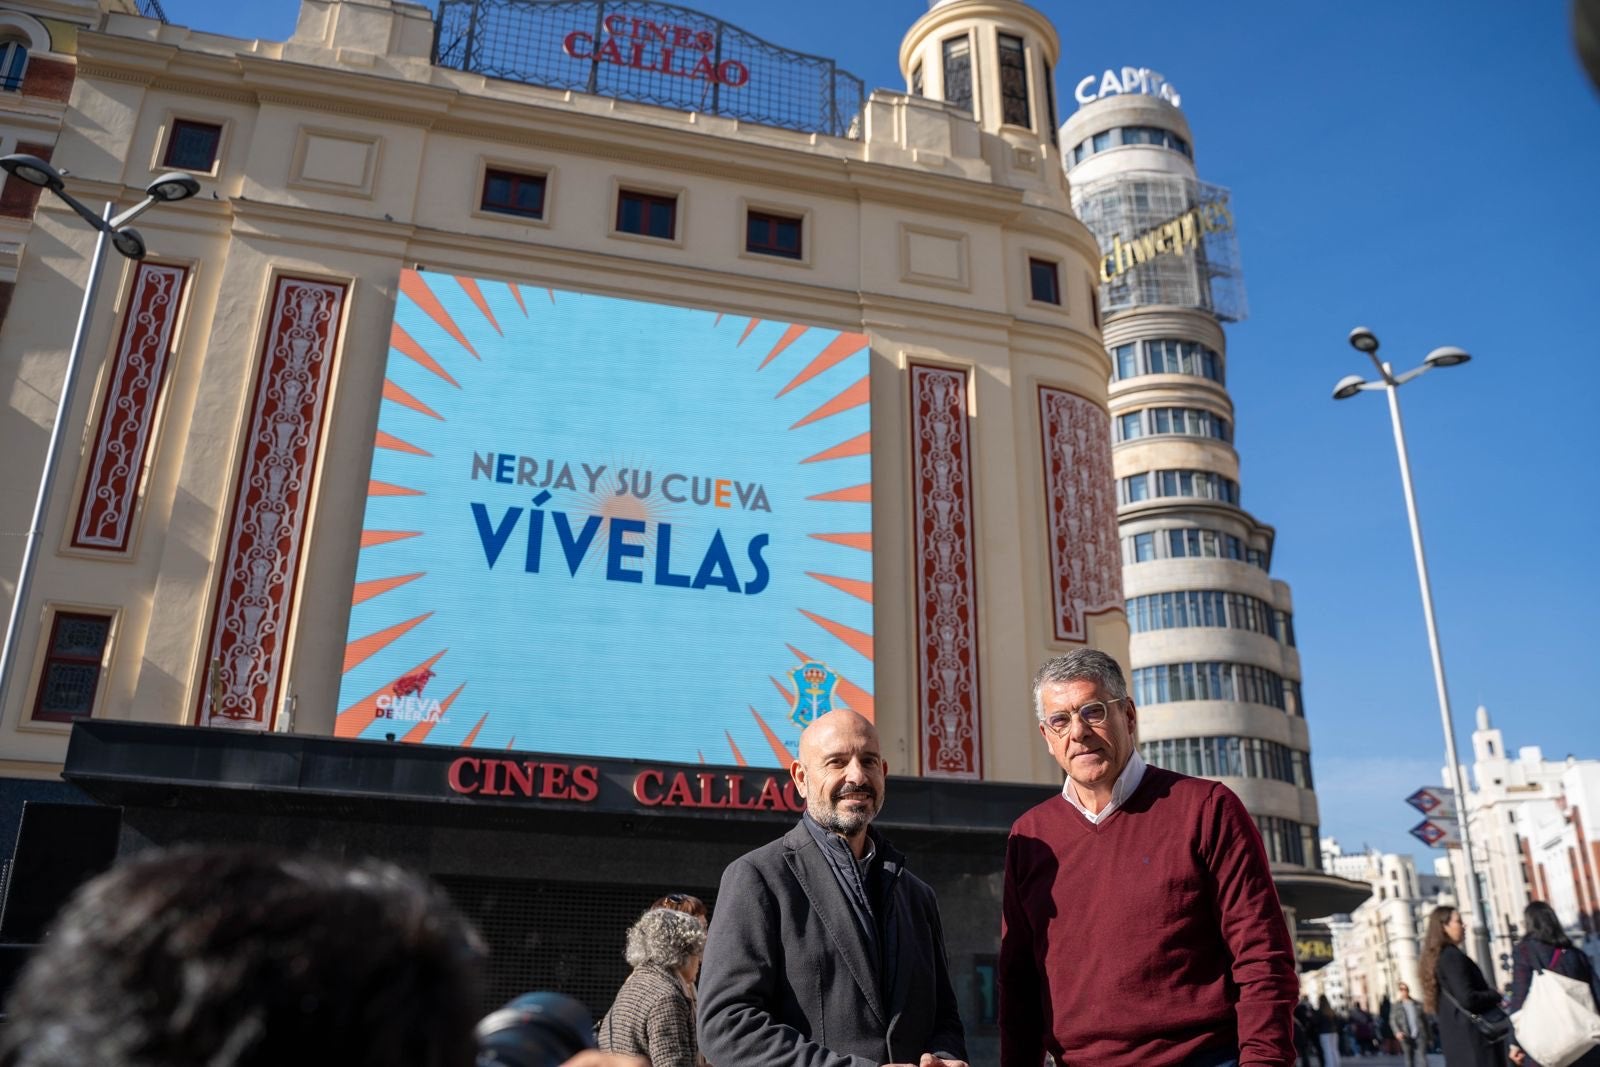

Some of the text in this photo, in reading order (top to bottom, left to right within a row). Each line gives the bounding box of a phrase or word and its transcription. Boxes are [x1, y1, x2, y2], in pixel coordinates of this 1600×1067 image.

[603, 13, 715, 52] CINES
[563, 30, 750, 88] CALLAO
[1075, 66, 1181, 108] CAPITO
[471, 450, 773, 513] NERJA Y SU CUEVA
[470, 489, 771, 596] VÍVELAS
[375, 694, 442, 714] CUEVA
[447, 754, 599, 802] CINES
